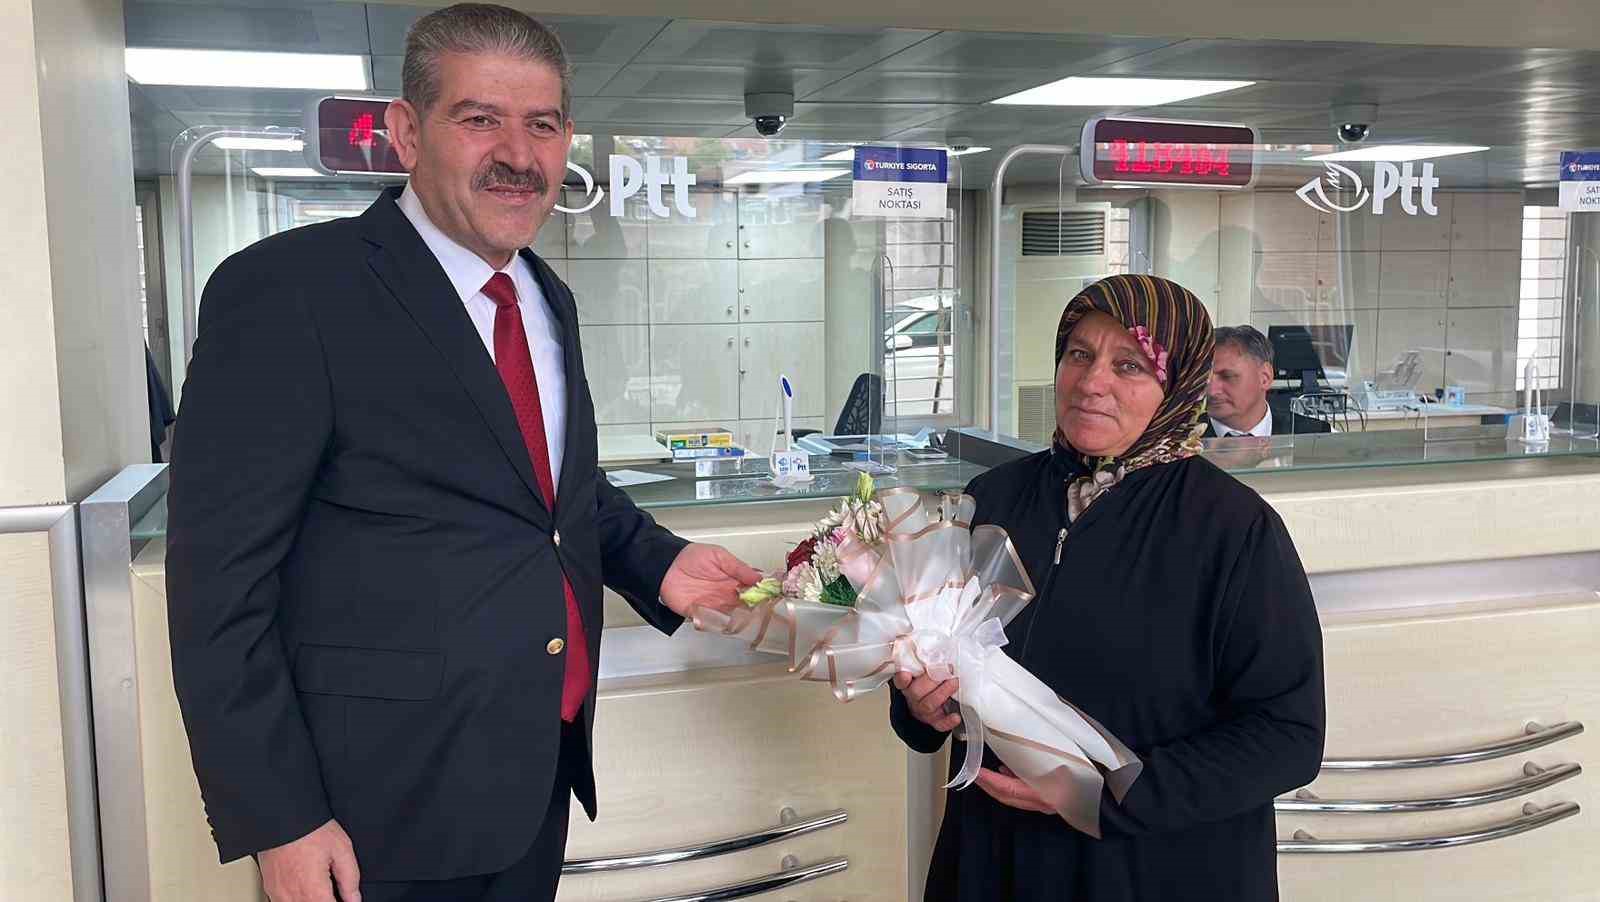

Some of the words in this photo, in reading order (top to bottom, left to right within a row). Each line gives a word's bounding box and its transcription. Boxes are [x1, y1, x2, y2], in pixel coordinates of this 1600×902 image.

[608, 154, 697, 218] Ptt
[879, 199, 921, 209] NOKTASI
[1372, 160, 1440, 216] Ptt
